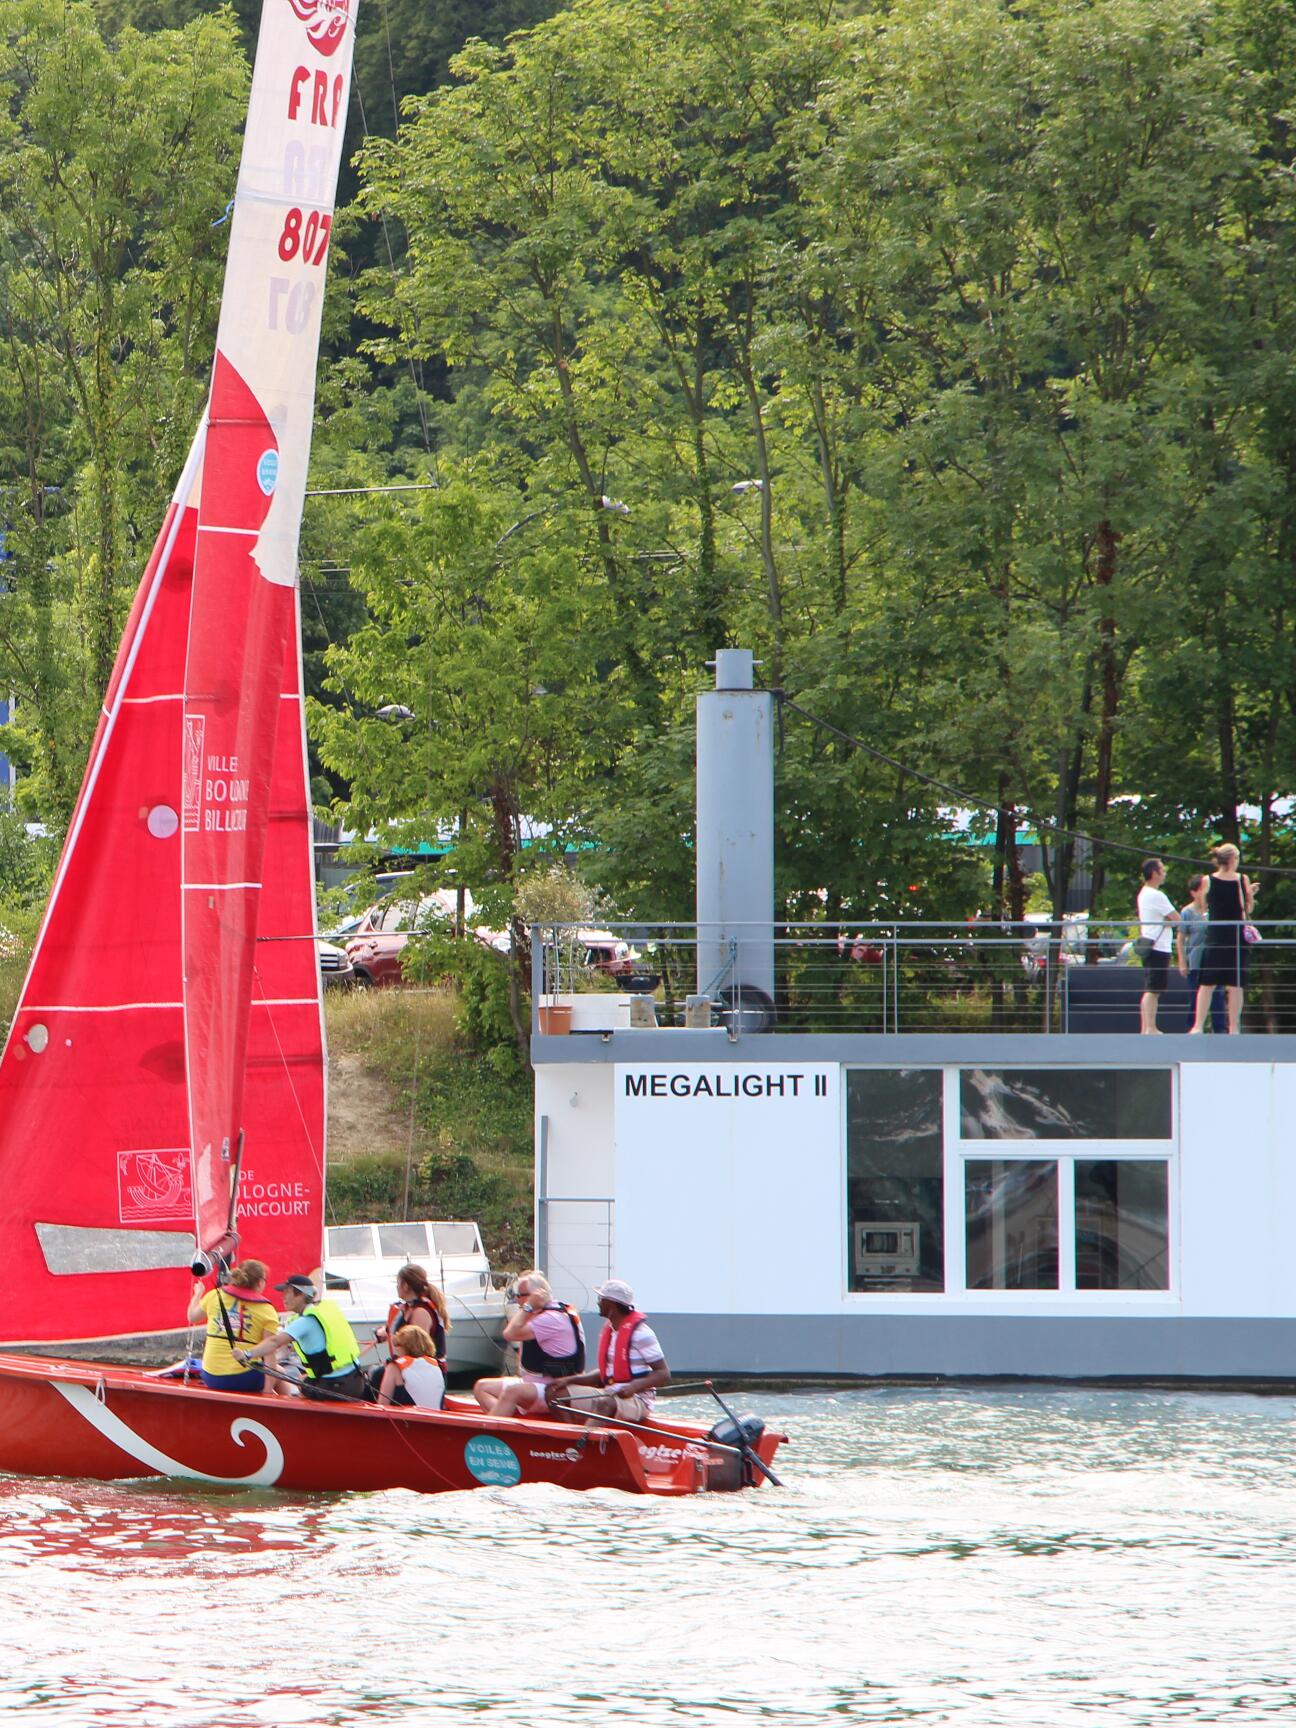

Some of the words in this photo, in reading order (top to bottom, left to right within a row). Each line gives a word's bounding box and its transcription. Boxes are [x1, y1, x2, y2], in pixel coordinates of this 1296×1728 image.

[278, 207, 332, 266] 807
[625, 1074, 804, 1097] MEGALIGHT
[815, 1075, 827, 1097] II
[238, 1170, 254, 1181] DE
[468, 1442, 511, 1456] VOILES
[469, 1455, 484, 1467] EN
[487, 1458, 518, 1471] SEINE
